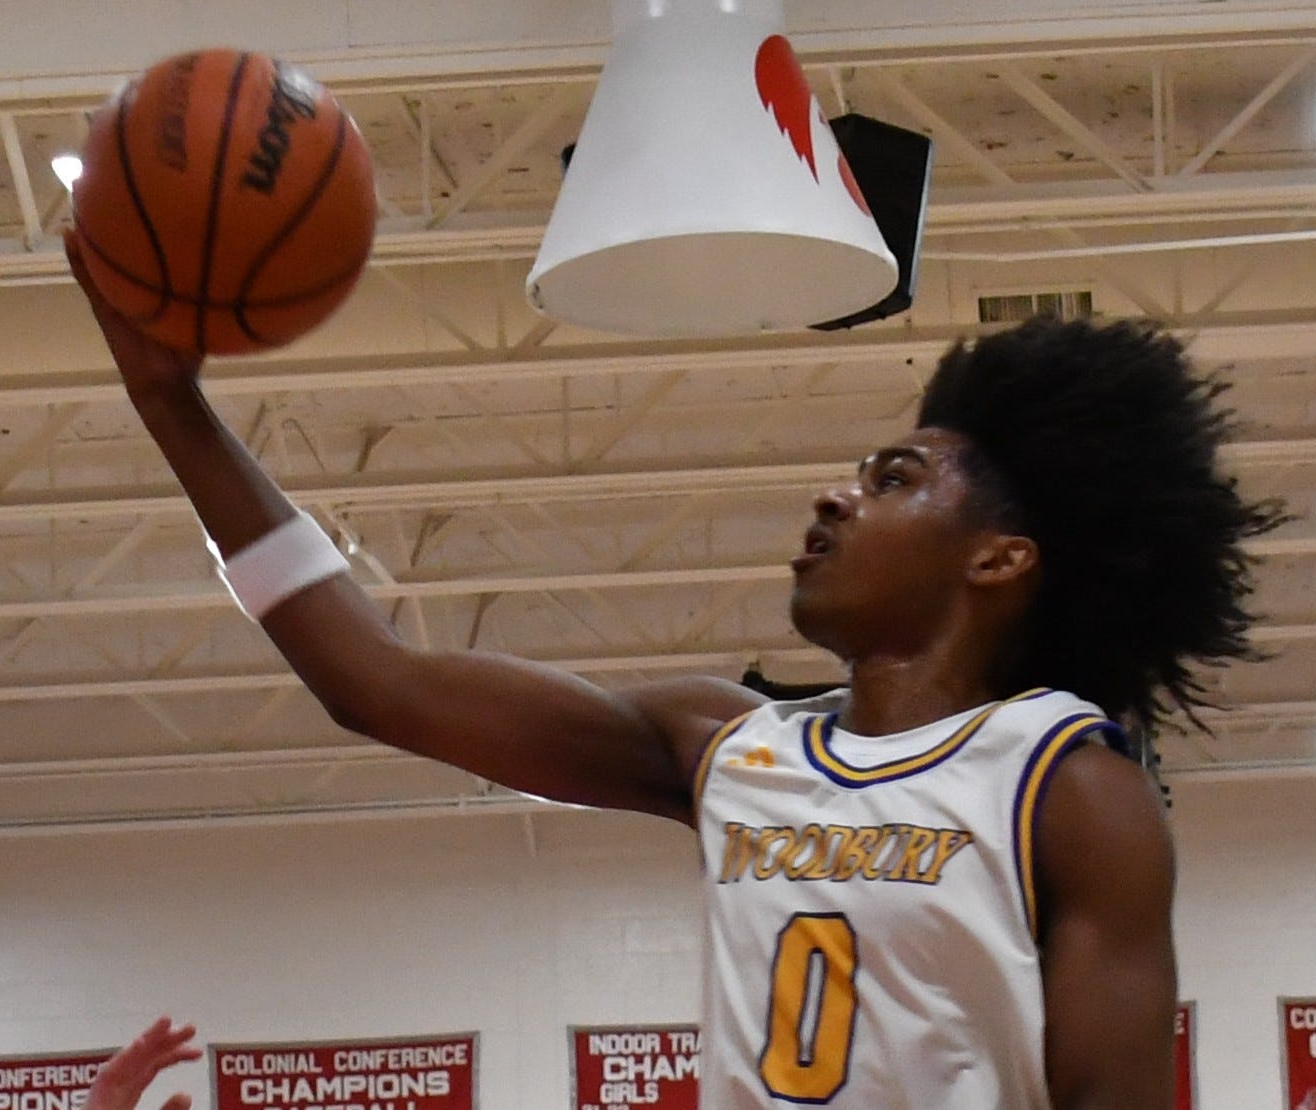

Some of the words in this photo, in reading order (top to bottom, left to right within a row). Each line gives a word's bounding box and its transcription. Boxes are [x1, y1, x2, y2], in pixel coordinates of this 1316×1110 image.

[718, 822, 975, 885] WOODBURY
[759, 912, 859, 1105] 0
[221, 1053, 323, 1076] COLONIAL
[334, 1044, 468, 1072] CONFERENCE
[240, 1071, 451, 1104] CHAMPIONS
[600, 1082, 659, 1105] GIRLS
